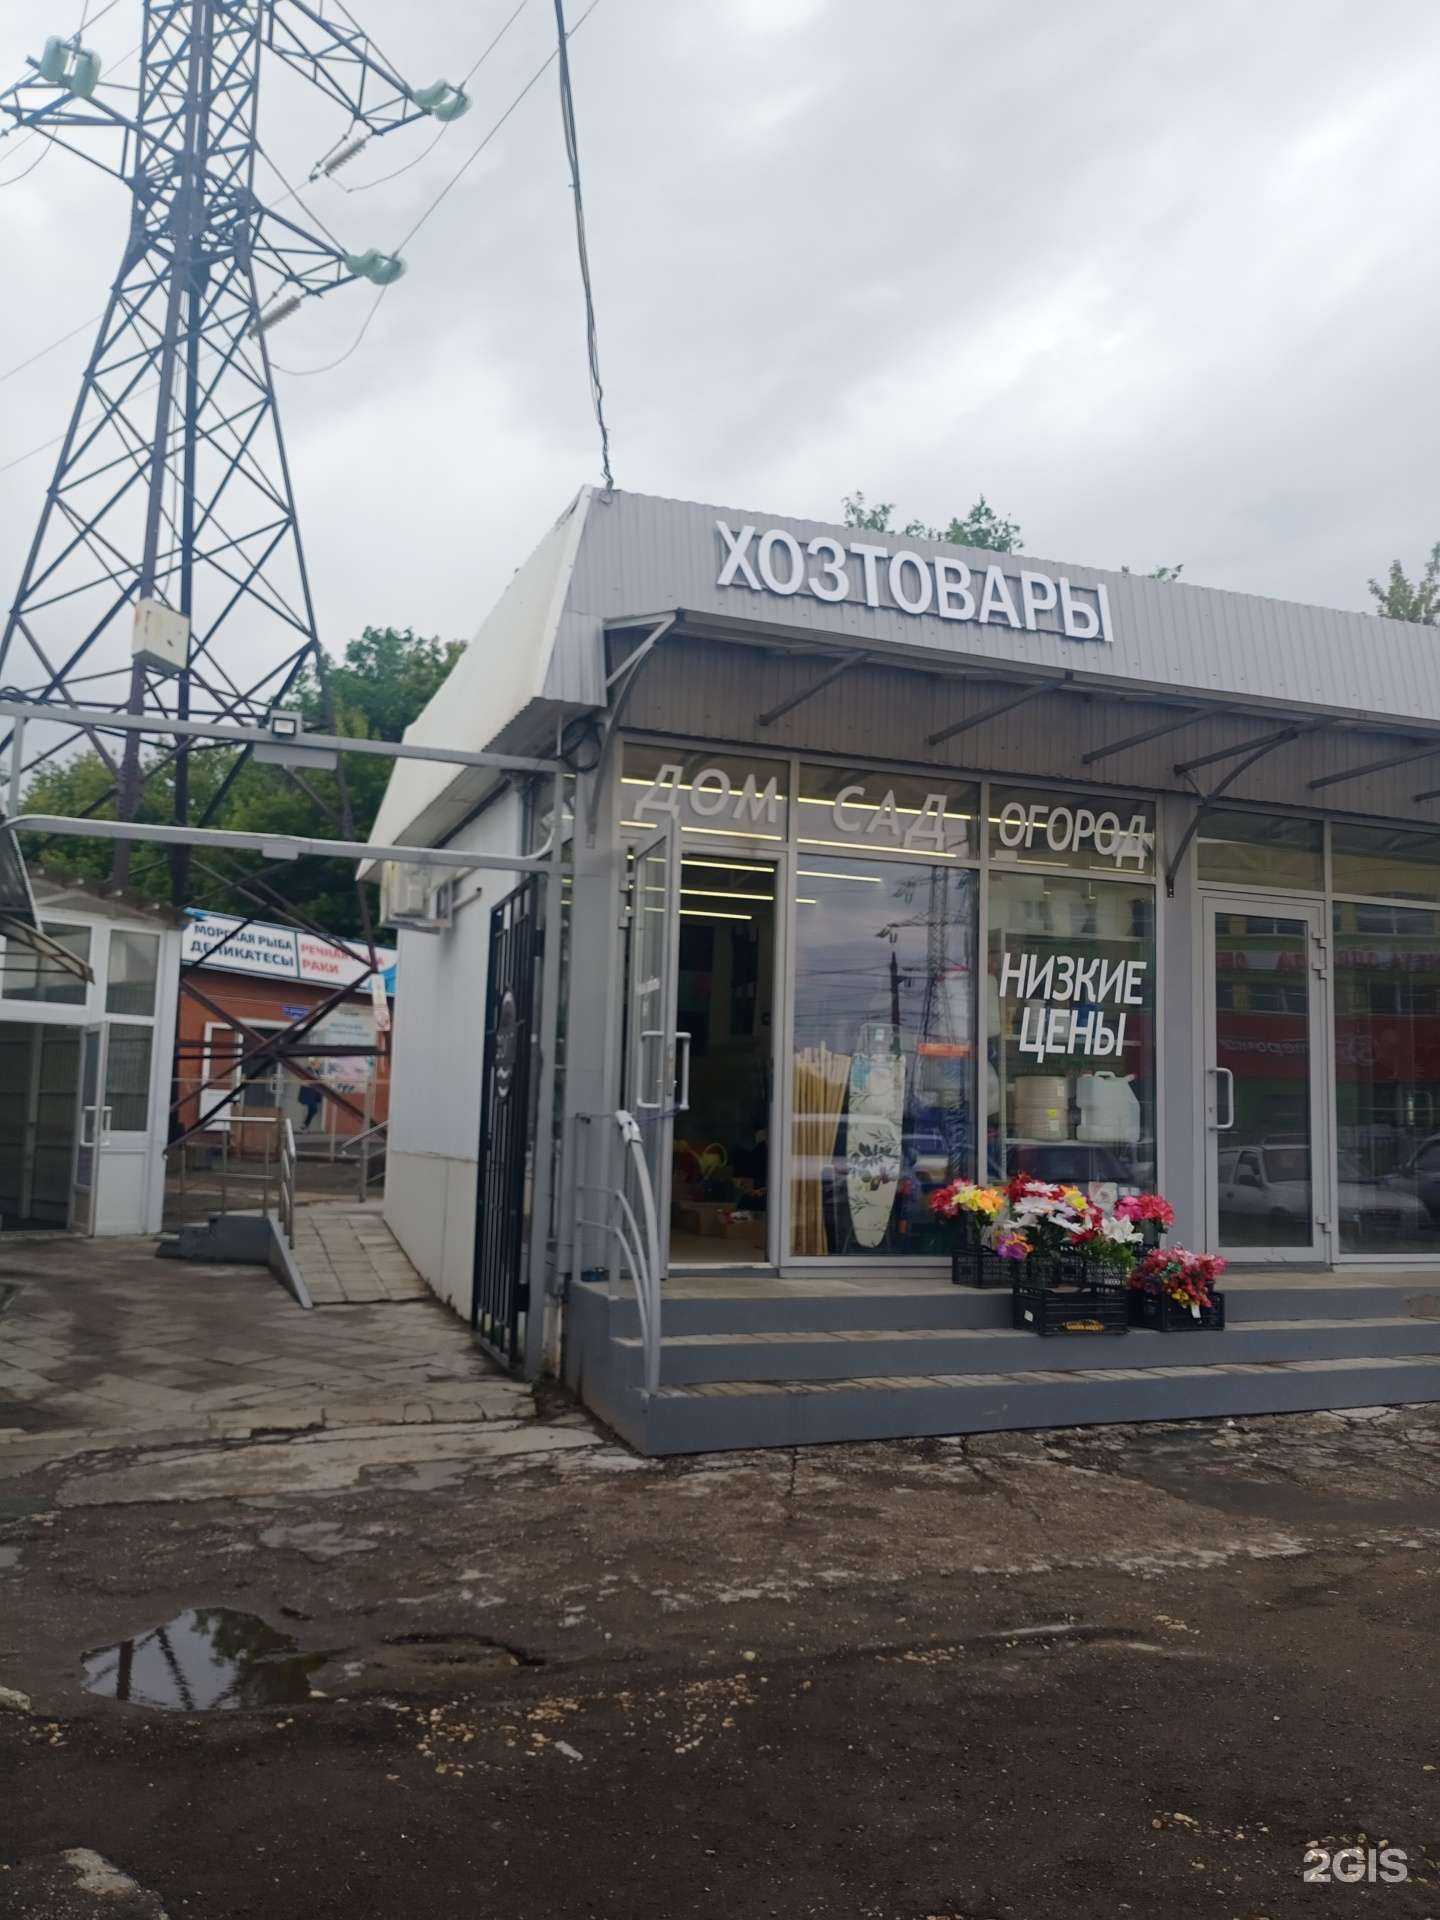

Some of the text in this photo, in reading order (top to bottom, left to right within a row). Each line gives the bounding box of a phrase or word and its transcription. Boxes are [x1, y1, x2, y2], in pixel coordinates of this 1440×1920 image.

[715, 519, 1115, 643] ХОЗТОВАРЫ
[633, 764, 1147, 869] ДОМ САД ОГОРОД
[258, 935, 292, 950] РЫБА
[302, 959, 339, 974] РАКИ
[1000, 953, 1147, 1005] НИЗКИЕ
[1019, 1006, 1126, 1063] ЦЕНЫ
